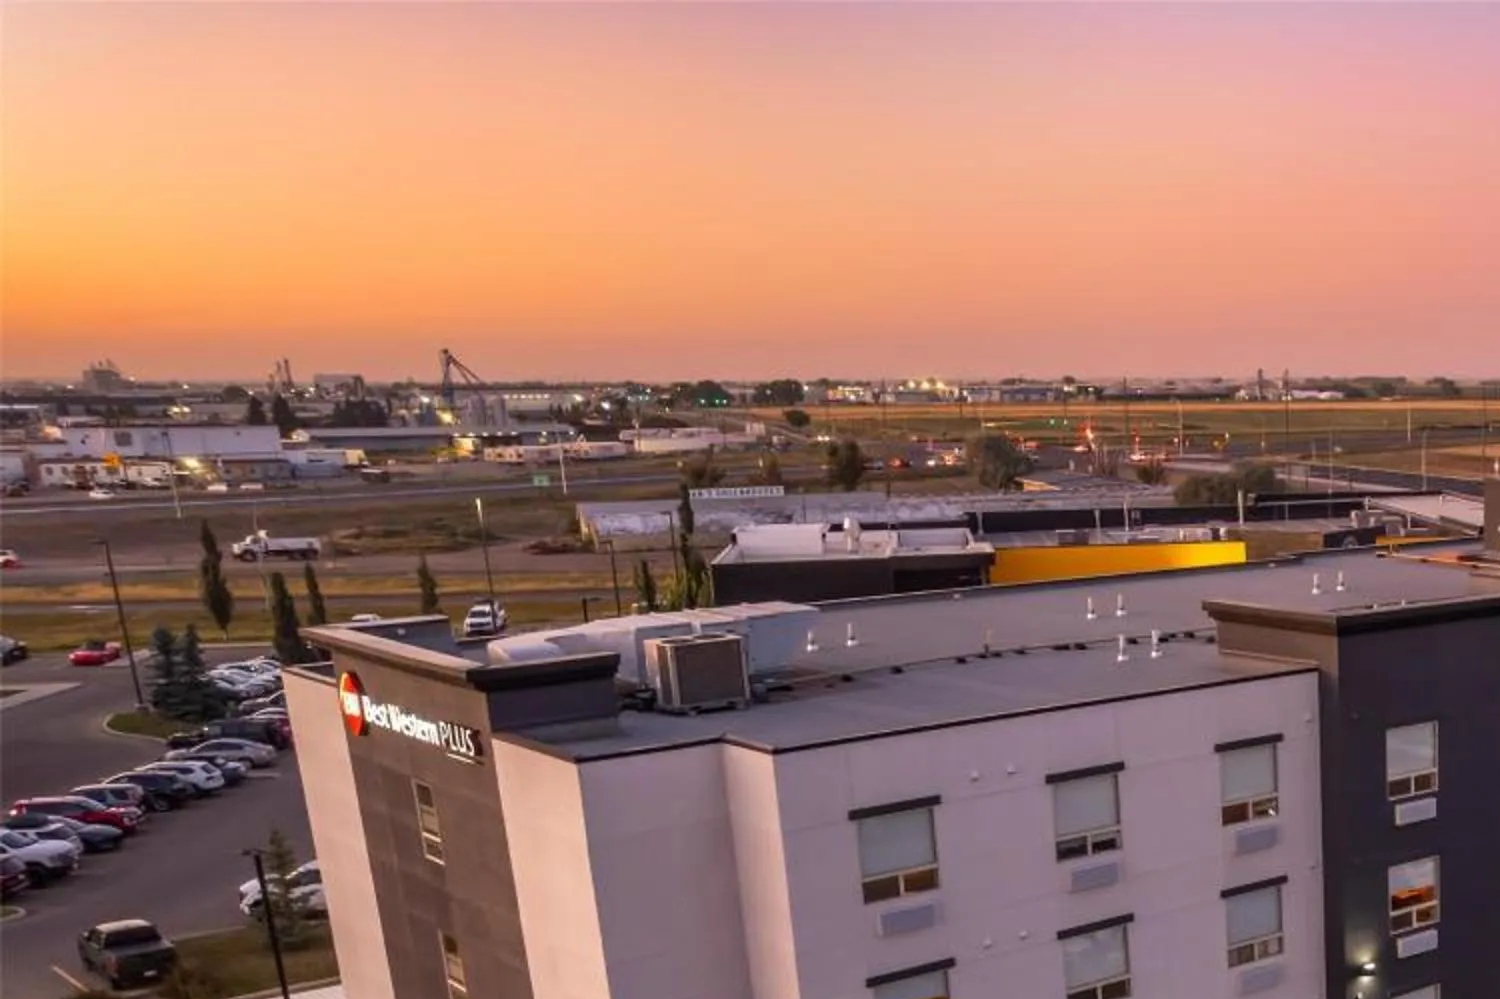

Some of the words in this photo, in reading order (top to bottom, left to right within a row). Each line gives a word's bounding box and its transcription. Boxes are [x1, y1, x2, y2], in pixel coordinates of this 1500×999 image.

[361, 695, 390, 729] Best
[387, 703, 441, 746] Western
[439, 720, 476, 757] PLUS
